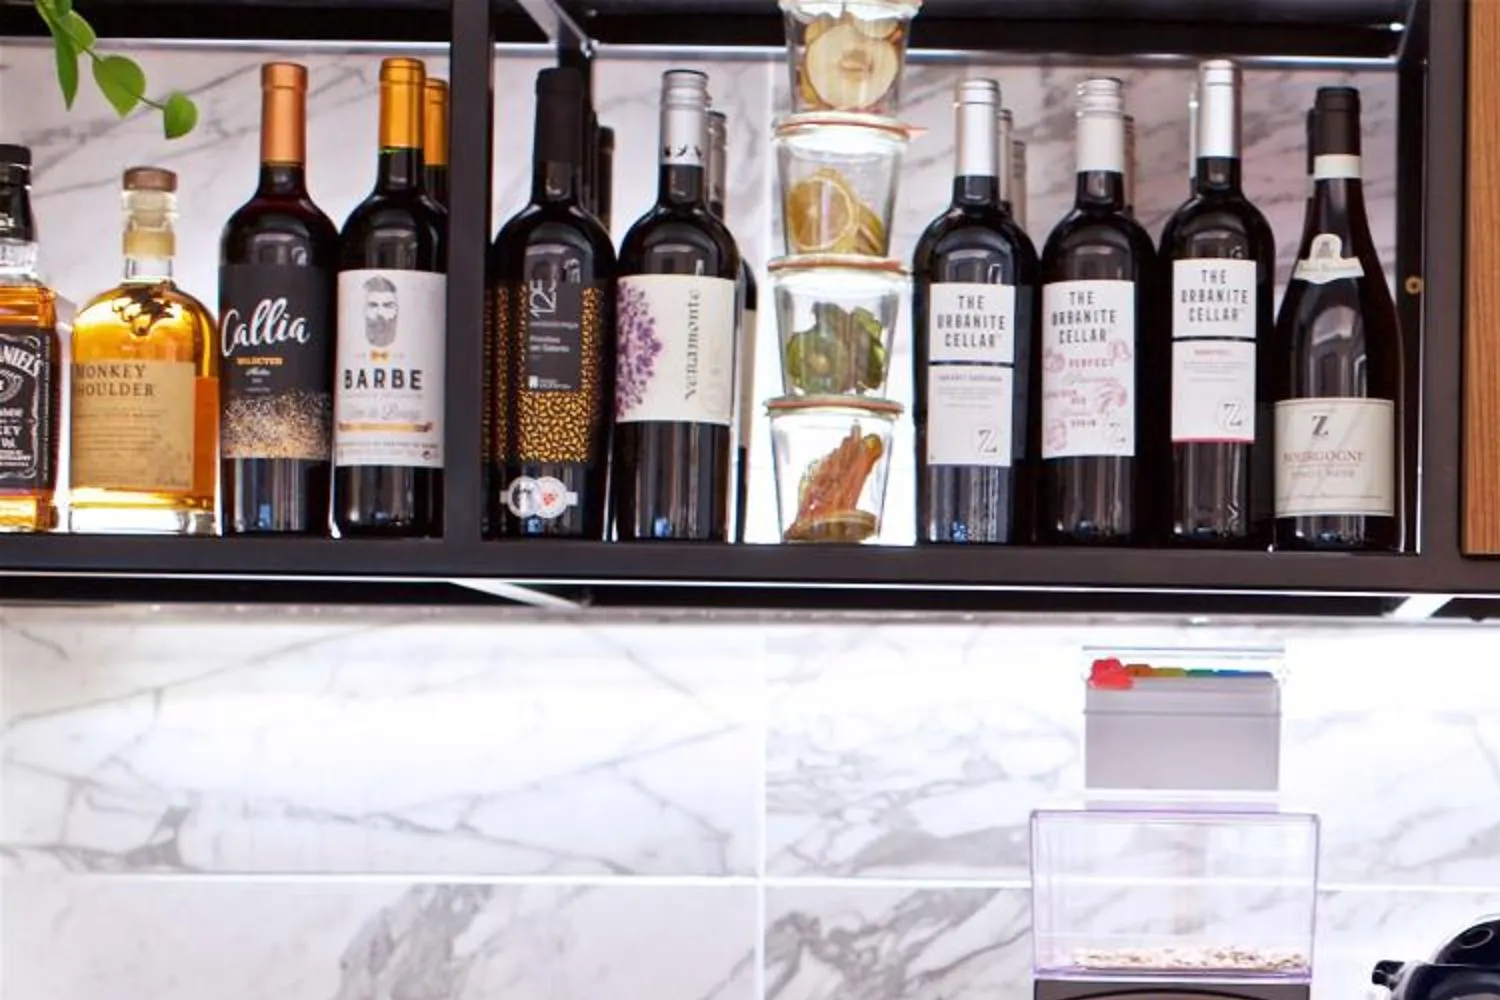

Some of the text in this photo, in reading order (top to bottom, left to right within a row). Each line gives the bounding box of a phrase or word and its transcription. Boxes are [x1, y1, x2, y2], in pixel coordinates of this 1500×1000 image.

[1202, 269, 1227, 284] THE
[958, 295, 986, 310] THE
[1069, 291, 1095, 305] THE
[1181, 289, 1249, 305] URBANITE
[936, 314, 1007, 331] URBANITE
[1052, 309, 1117, 327] URBANITE
[1188, 307, 1240, 324] CELLAR
[221, 297, 311, 356] Callia
[944, 333, 997, 348] CELLAR
[1059, 328, 1107, 345] CELLAR
[344, 367, 424, 391] BARBE
[75, 383, 155, 397] HOULDER
[1311, 414, 1330, 437] Z
[977, 429, 999, 454] Z
